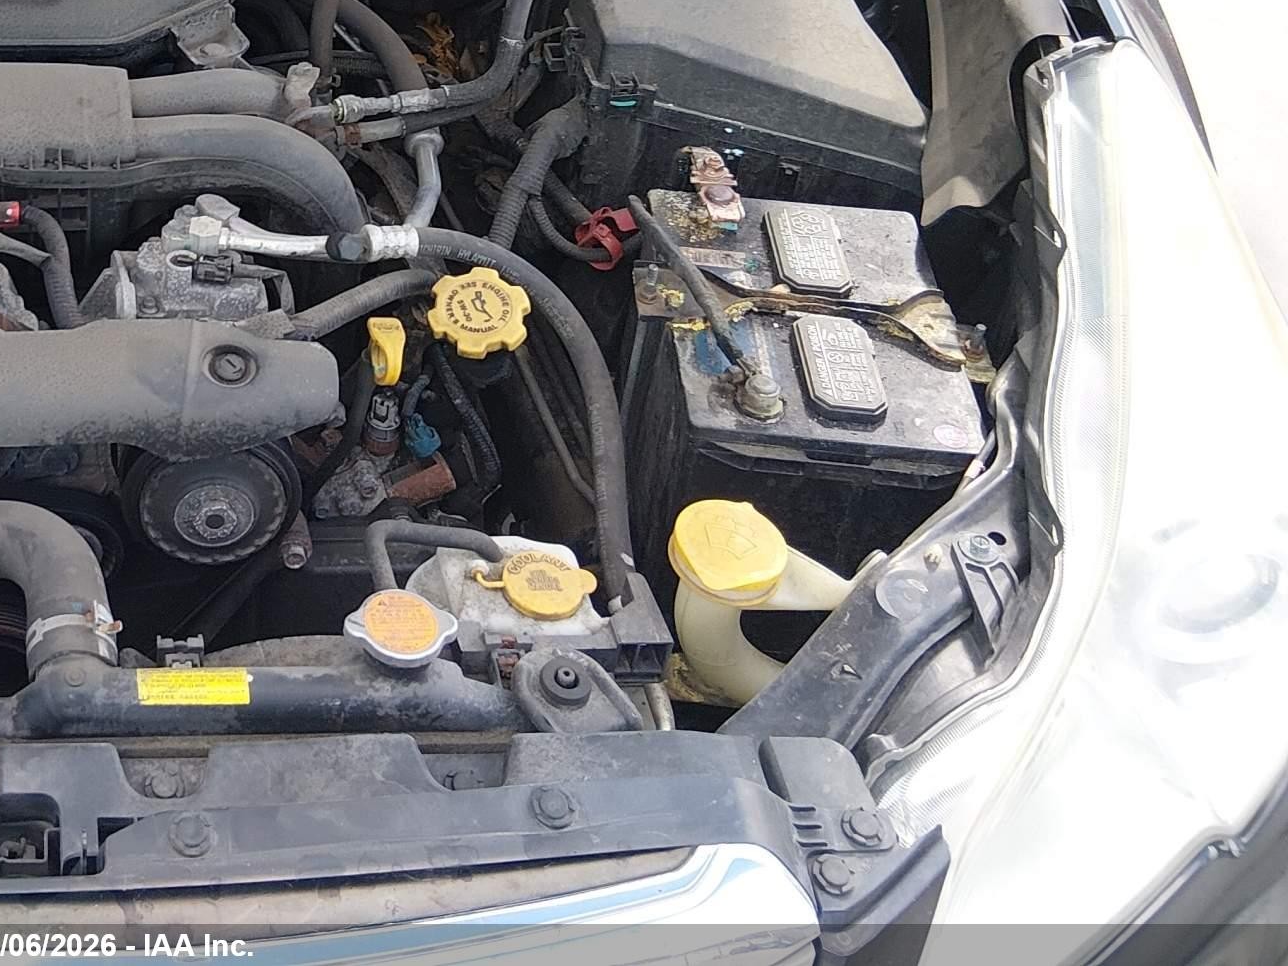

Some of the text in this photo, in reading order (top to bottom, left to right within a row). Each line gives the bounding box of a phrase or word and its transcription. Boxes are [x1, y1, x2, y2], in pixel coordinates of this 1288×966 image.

[481, 282, 510, 322] ENGINE OIL
[459, 323, 498, 333] MANUAL
[815, 356, 833, 389] DANGER
